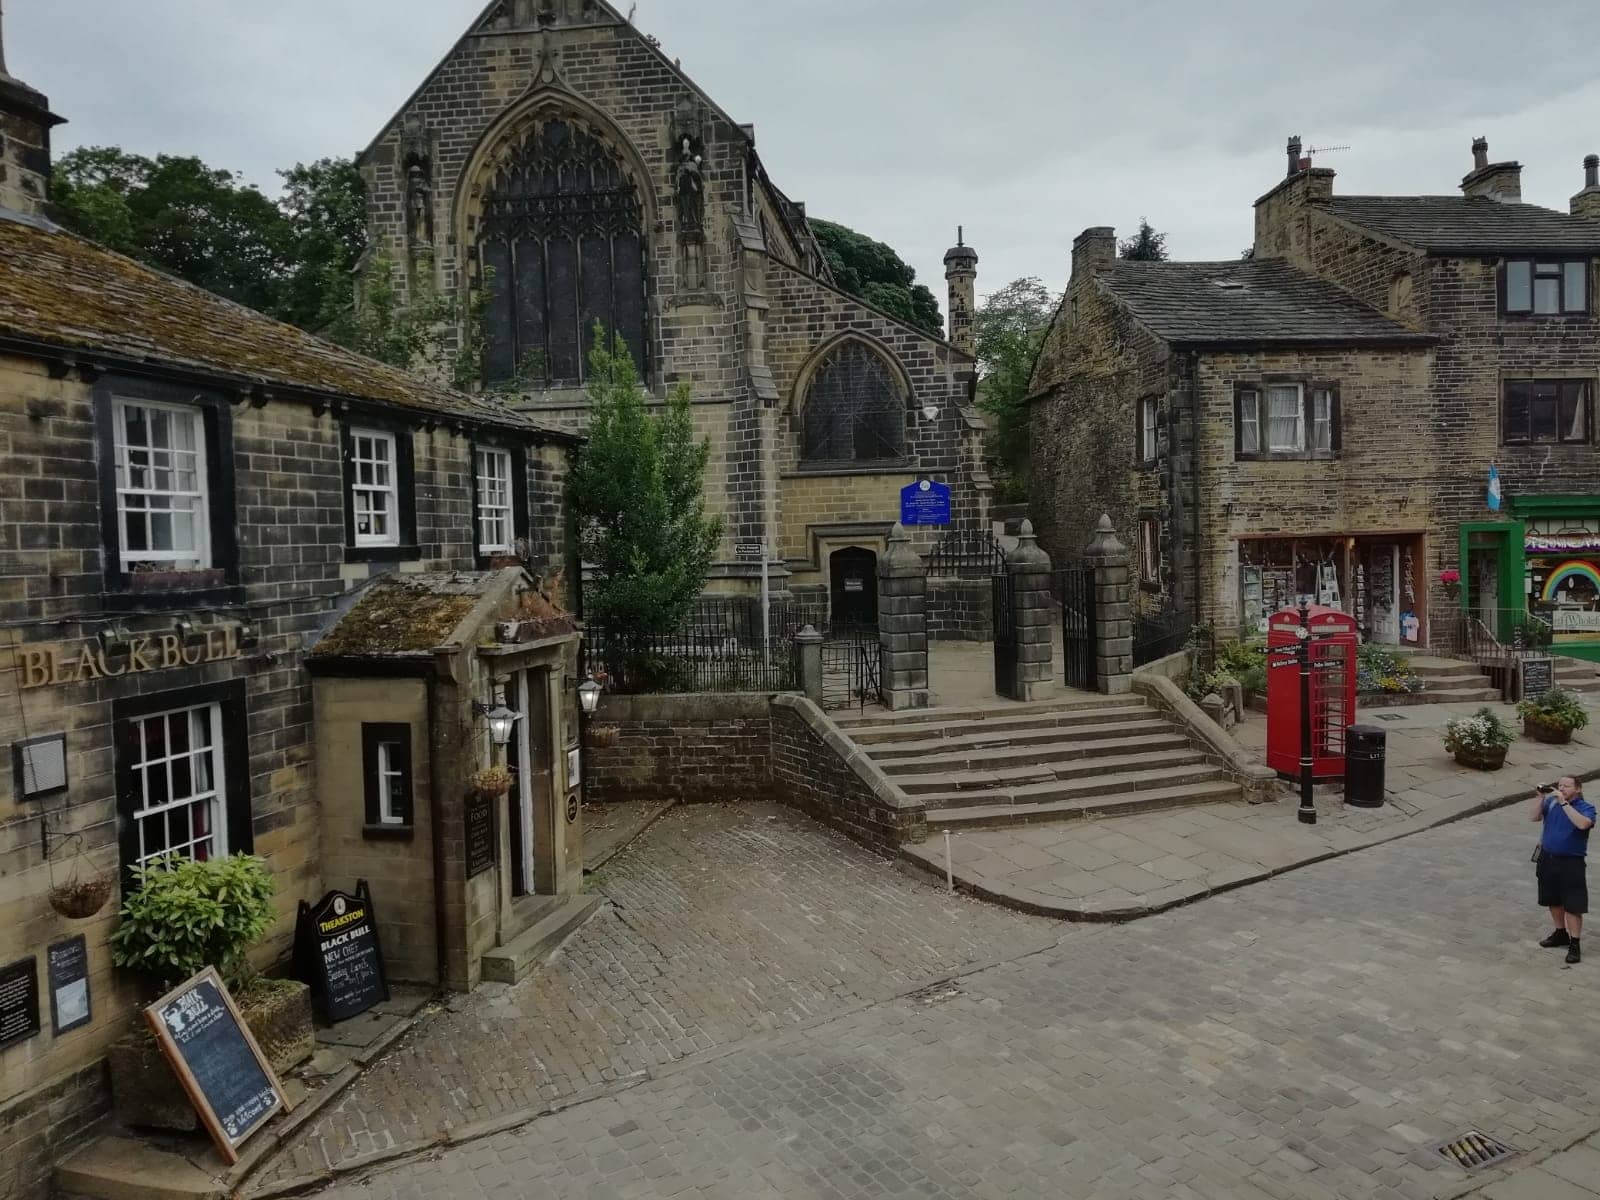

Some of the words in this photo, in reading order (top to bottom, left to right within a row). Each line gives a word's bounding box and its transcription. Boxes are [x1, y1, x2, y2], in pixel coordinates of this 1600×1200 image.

[21, 637, 150, 689] BLACK
[160, 625, 242, 669] BULL
[320, 909, 364, 933] THEAKSTON
[321, 935, 349, 952] BLACK
[350, 925, 370, 939] BULL
